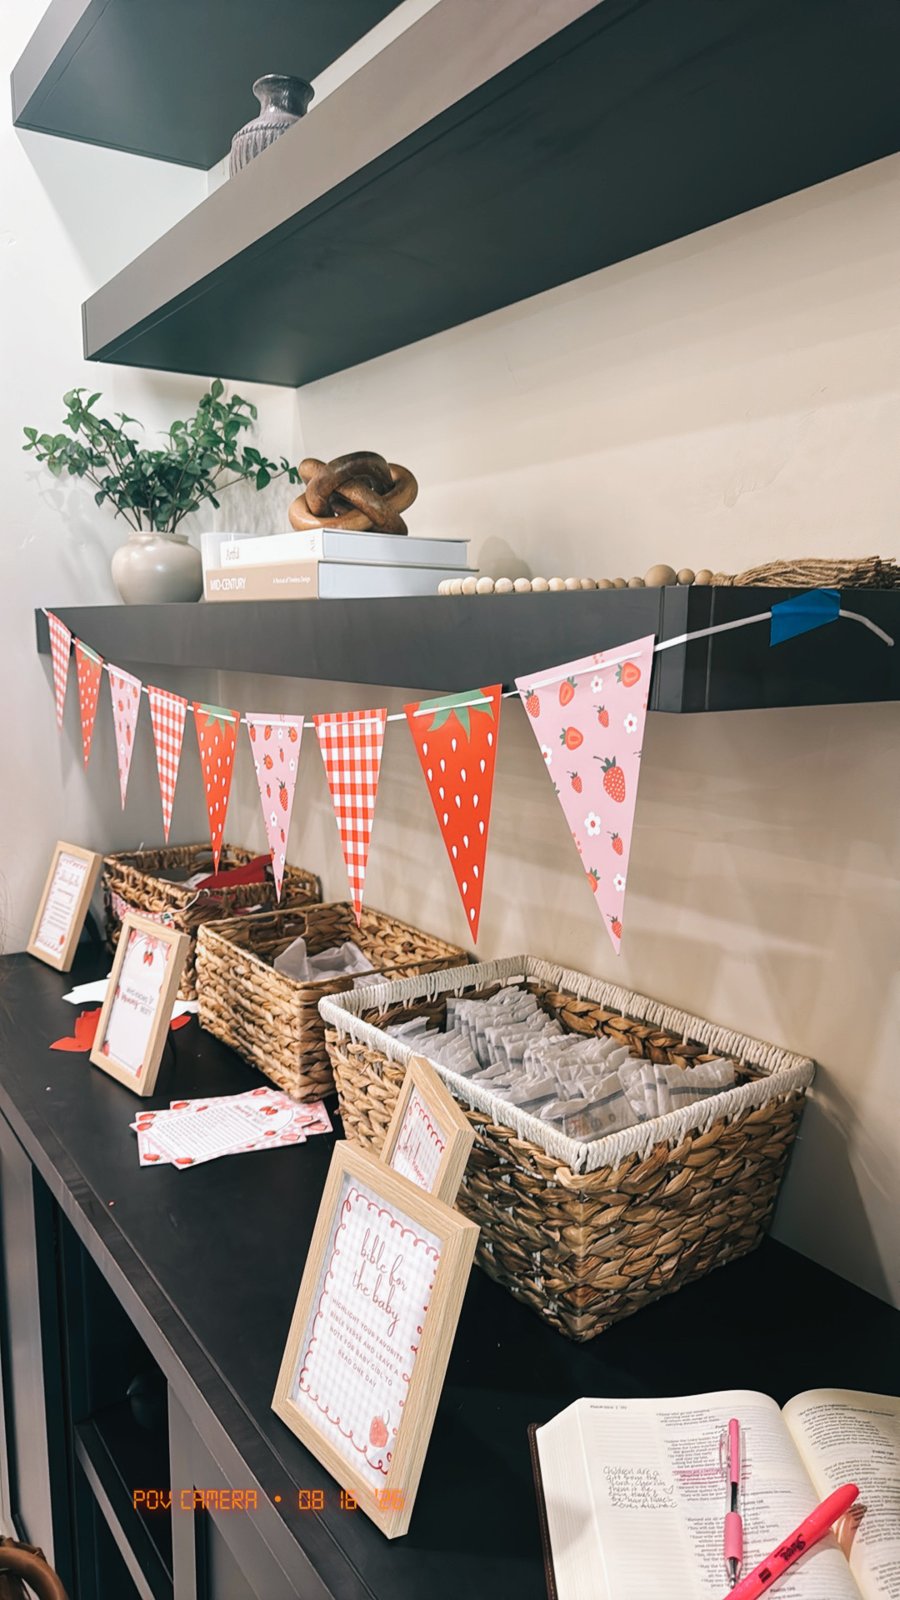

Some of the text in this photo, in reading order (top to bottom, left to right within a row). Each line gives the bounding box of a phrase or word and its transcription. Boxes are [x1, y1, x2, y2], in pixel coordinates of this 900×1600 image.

[210, 577, 247, 591] MID-CENTURY
[361, 1228, 408, 1291] bible for
[352, 1260, 400, 1337] the baby
[329, 1326, 393, 1387] NOTE FOR BABY GIRL TO
[330, 1310, 345, 1326] BIBLE
[345, 1324, 362, 1343] VERSE
[362, 1339, 375, 1354] AND
[376, 1352, 393, 1371] LEAVE
[332, 1298, 404, 1363] HIGHLIGHT YOUR FAVORITE
[338, 1349, 377, 1389] READ ONE DAY
